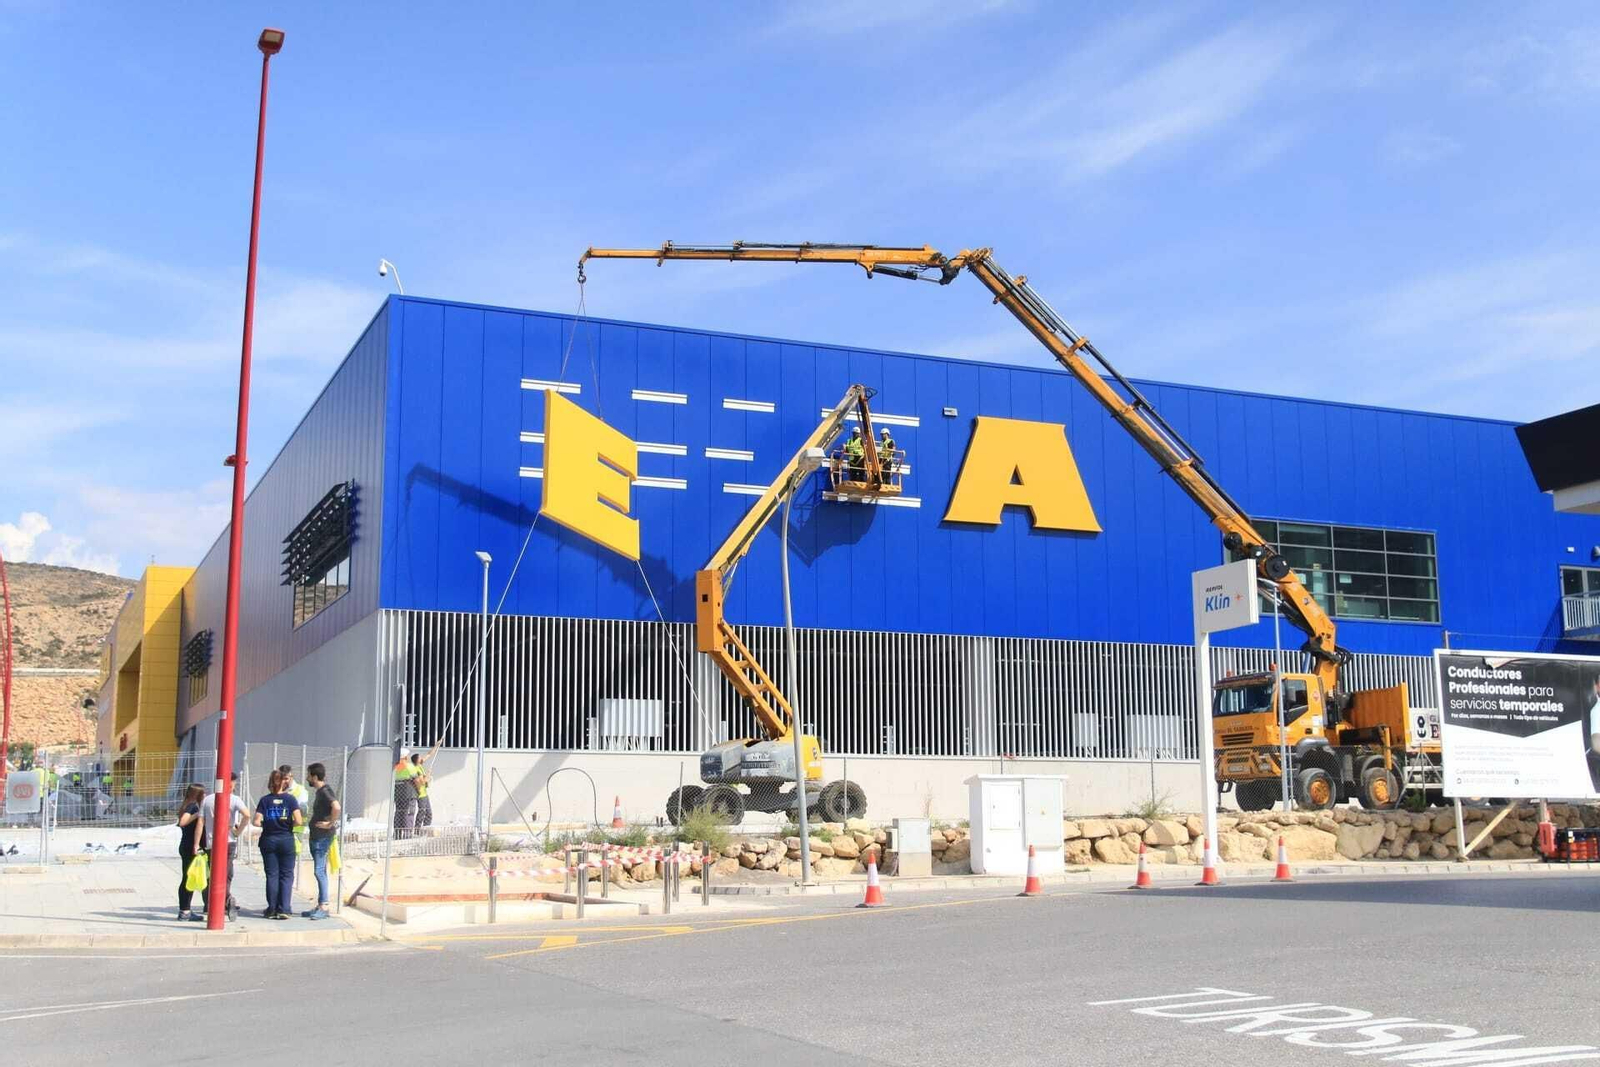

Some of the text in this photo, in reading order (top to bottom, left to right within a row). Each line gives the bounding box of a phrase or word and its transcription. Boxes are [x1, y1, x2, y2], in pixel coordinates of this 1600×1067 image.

[539, 388, 641, 562] E
[942, 415, 1104, 533] A
[1205, 593, 1230, 613] Klin
[1447, 665, 1522, 680] Conductores
[1448, 681, 1554, 699] Profesionales para
[1450, 697, 1564, 716] servicios temporales
[1087, 987, 1600, 1067] TURISM
